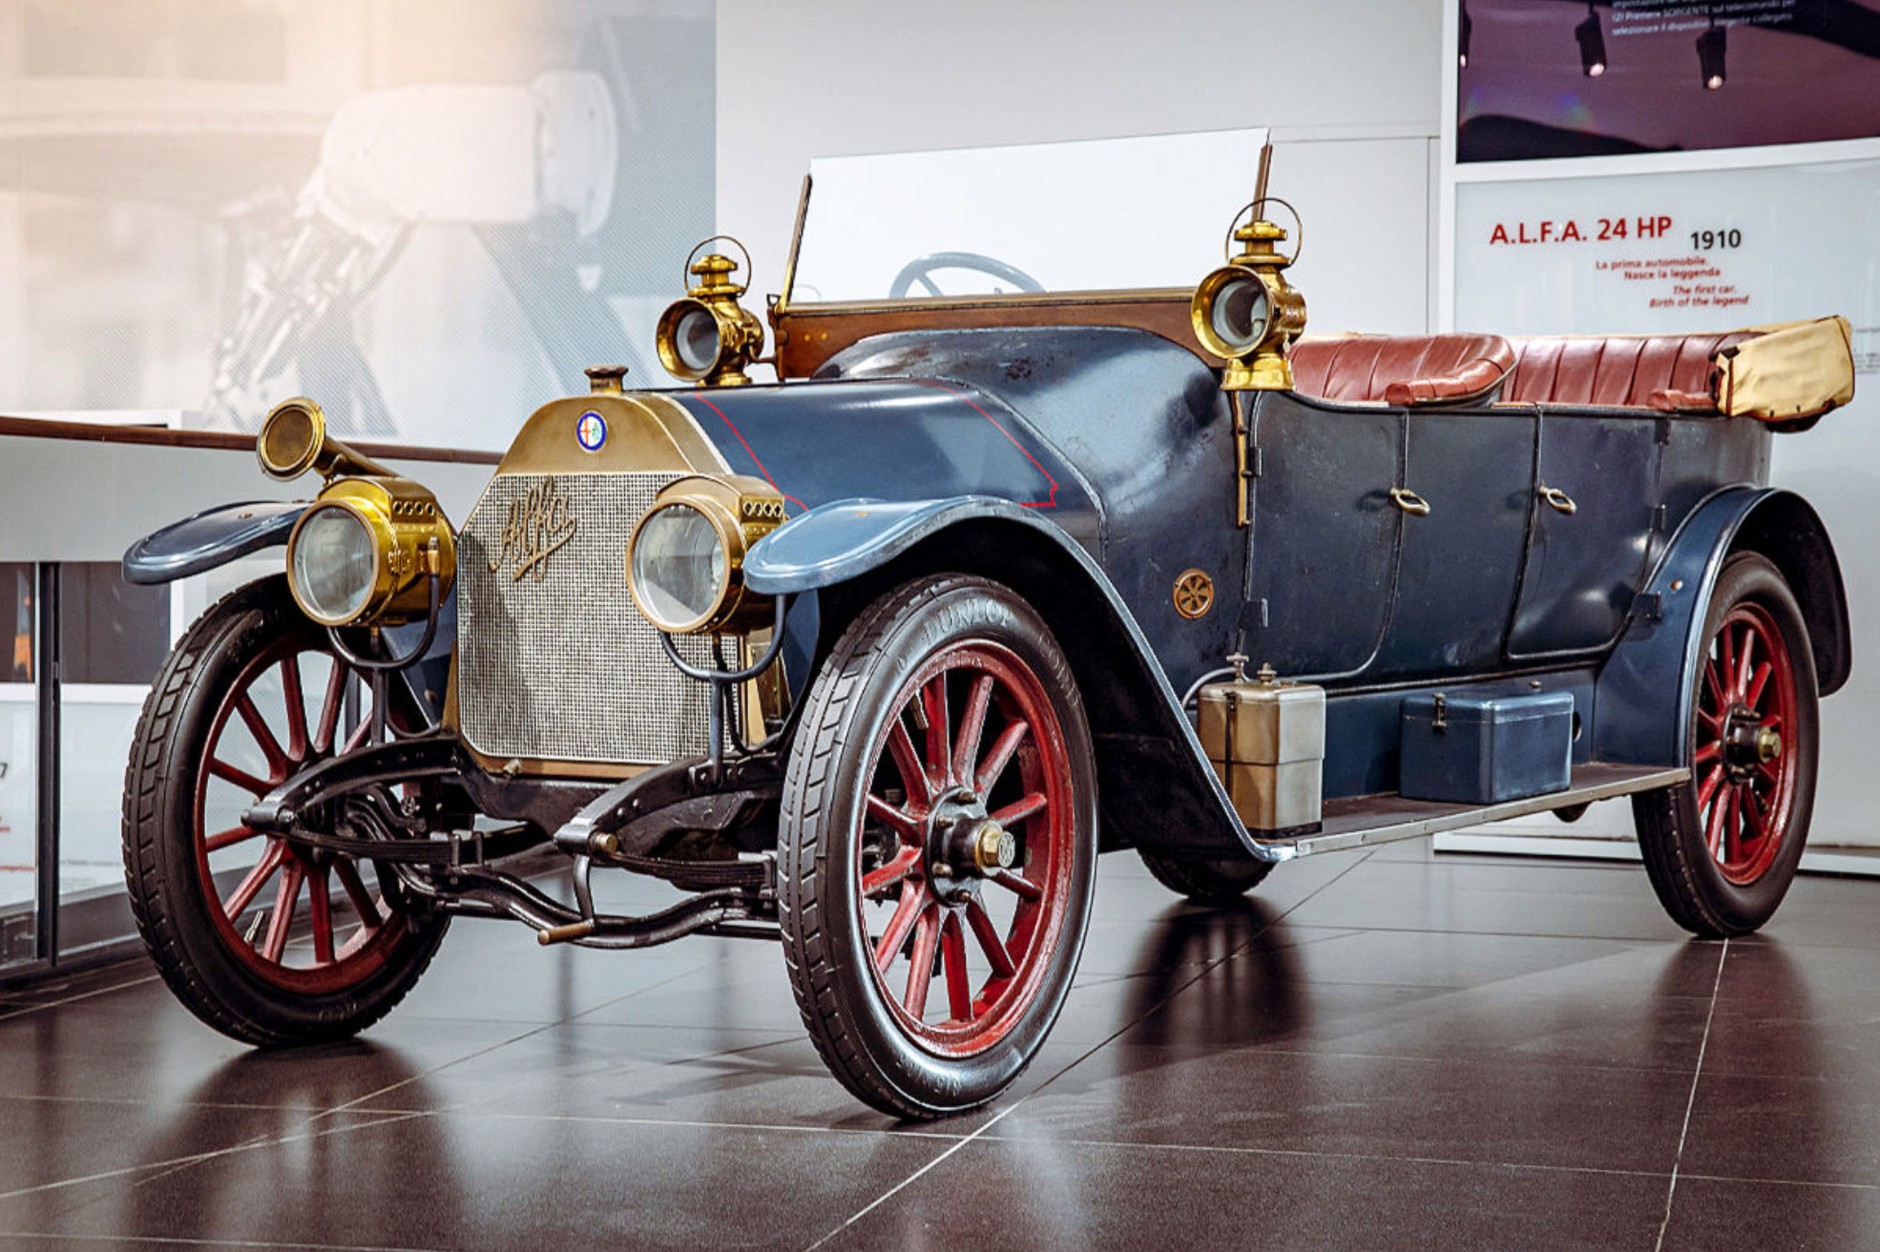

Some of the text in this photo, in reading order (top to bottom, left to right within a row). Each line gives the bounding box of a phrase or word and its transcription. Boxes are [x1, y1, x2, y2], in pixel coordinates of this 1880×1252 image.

[1663, 5, 1709, 17] SORGENTE
[1489, 216, 1672, 245] A.L.F.A. 24 HP
[1690, 229, 1741, 250] 1910
[1596, 260, 1608, 270] La
[1611, 259, 1641, 271] prima
[1624, 267, 1720, 280] Nasce la leggenda
[1673, 284, 1736, 295] The first car.
[1649, 295, 1749, 308] Birth of the legend
[488, 474, 577, 582] Alfa
[924, 598, 1012, 646] DUNLOP
